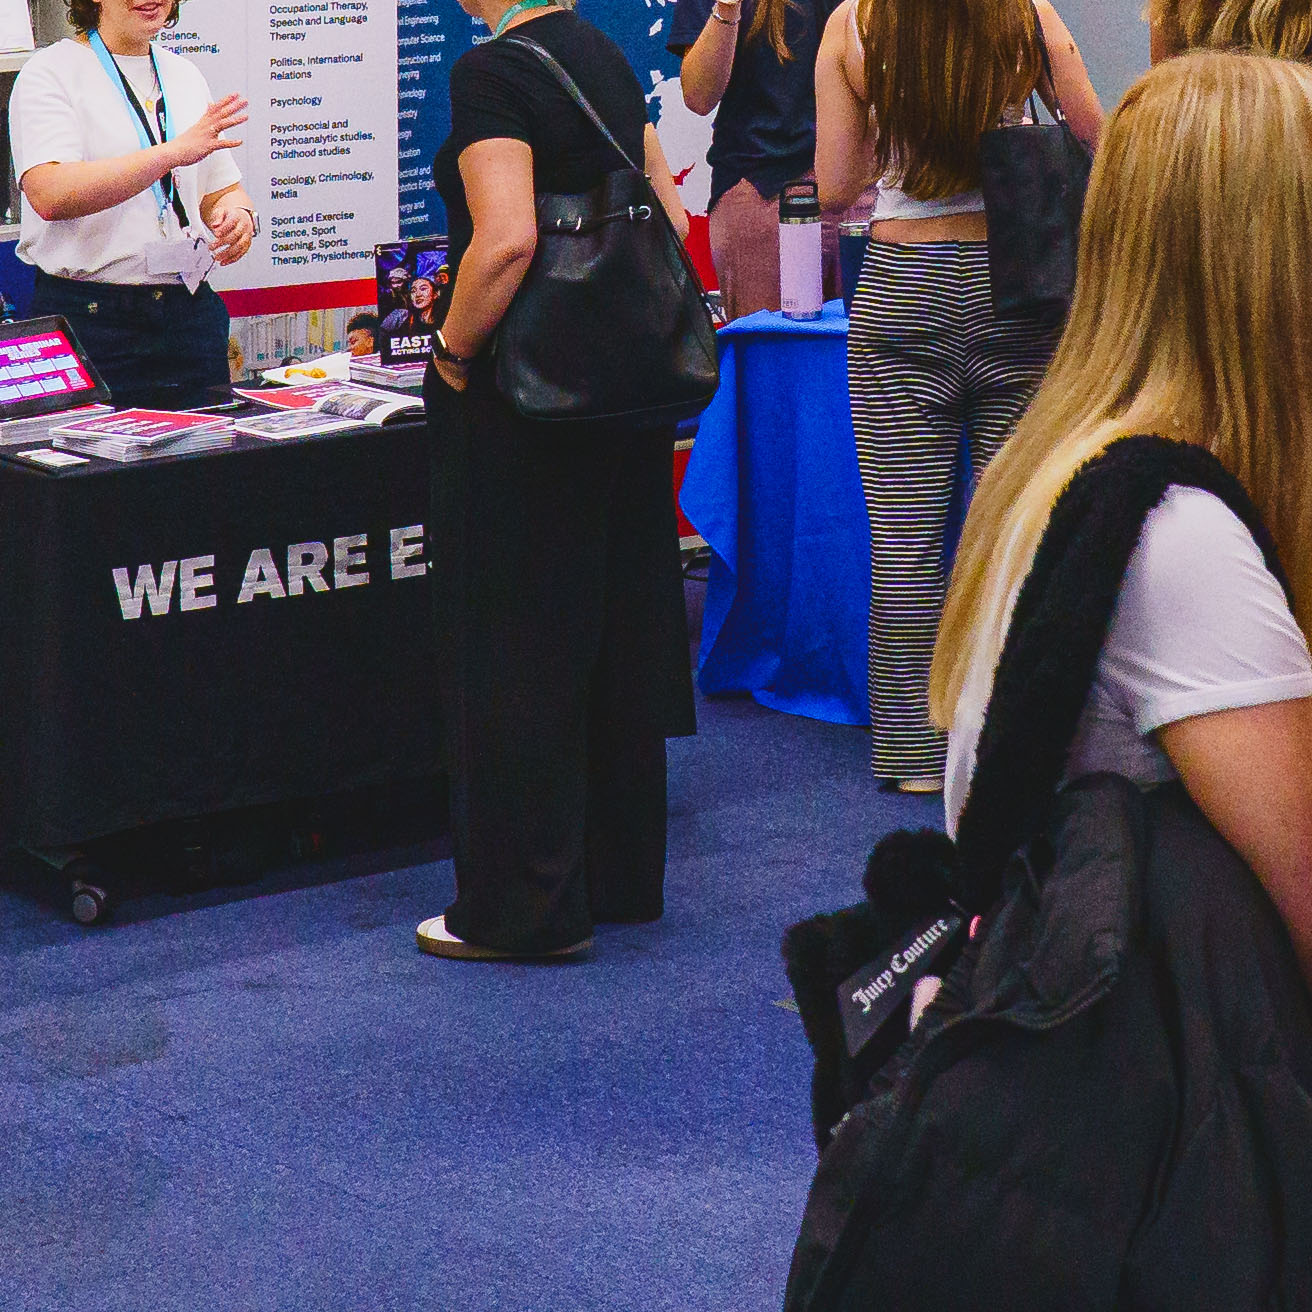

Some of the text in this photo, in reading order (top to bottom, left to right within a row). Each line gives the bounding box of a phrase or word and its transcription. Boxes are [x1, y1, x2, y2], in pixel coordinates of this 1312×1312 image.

[270, 1, 368, 15] Occupational Therapy,
[270, 53, 363, 69] Politics, International
[270, 70, 312, 81] Relations
[270, 96, 322, 108] Psychology
[270, 119, 348, 134] Psychosocial and
[270, 131, 376, 148] Psychoanalytic studies,
[271, 211, 354, 228] Sport and Exercise
[271, 250, 375, 268] Therapy, Physiotherapy
[391, 335, 431, 349] EAST
[112, 554, 217, 620] WE
[237, 533, 370, 603] ARE
[852, 920, 948, 1013] Juicy Couture
